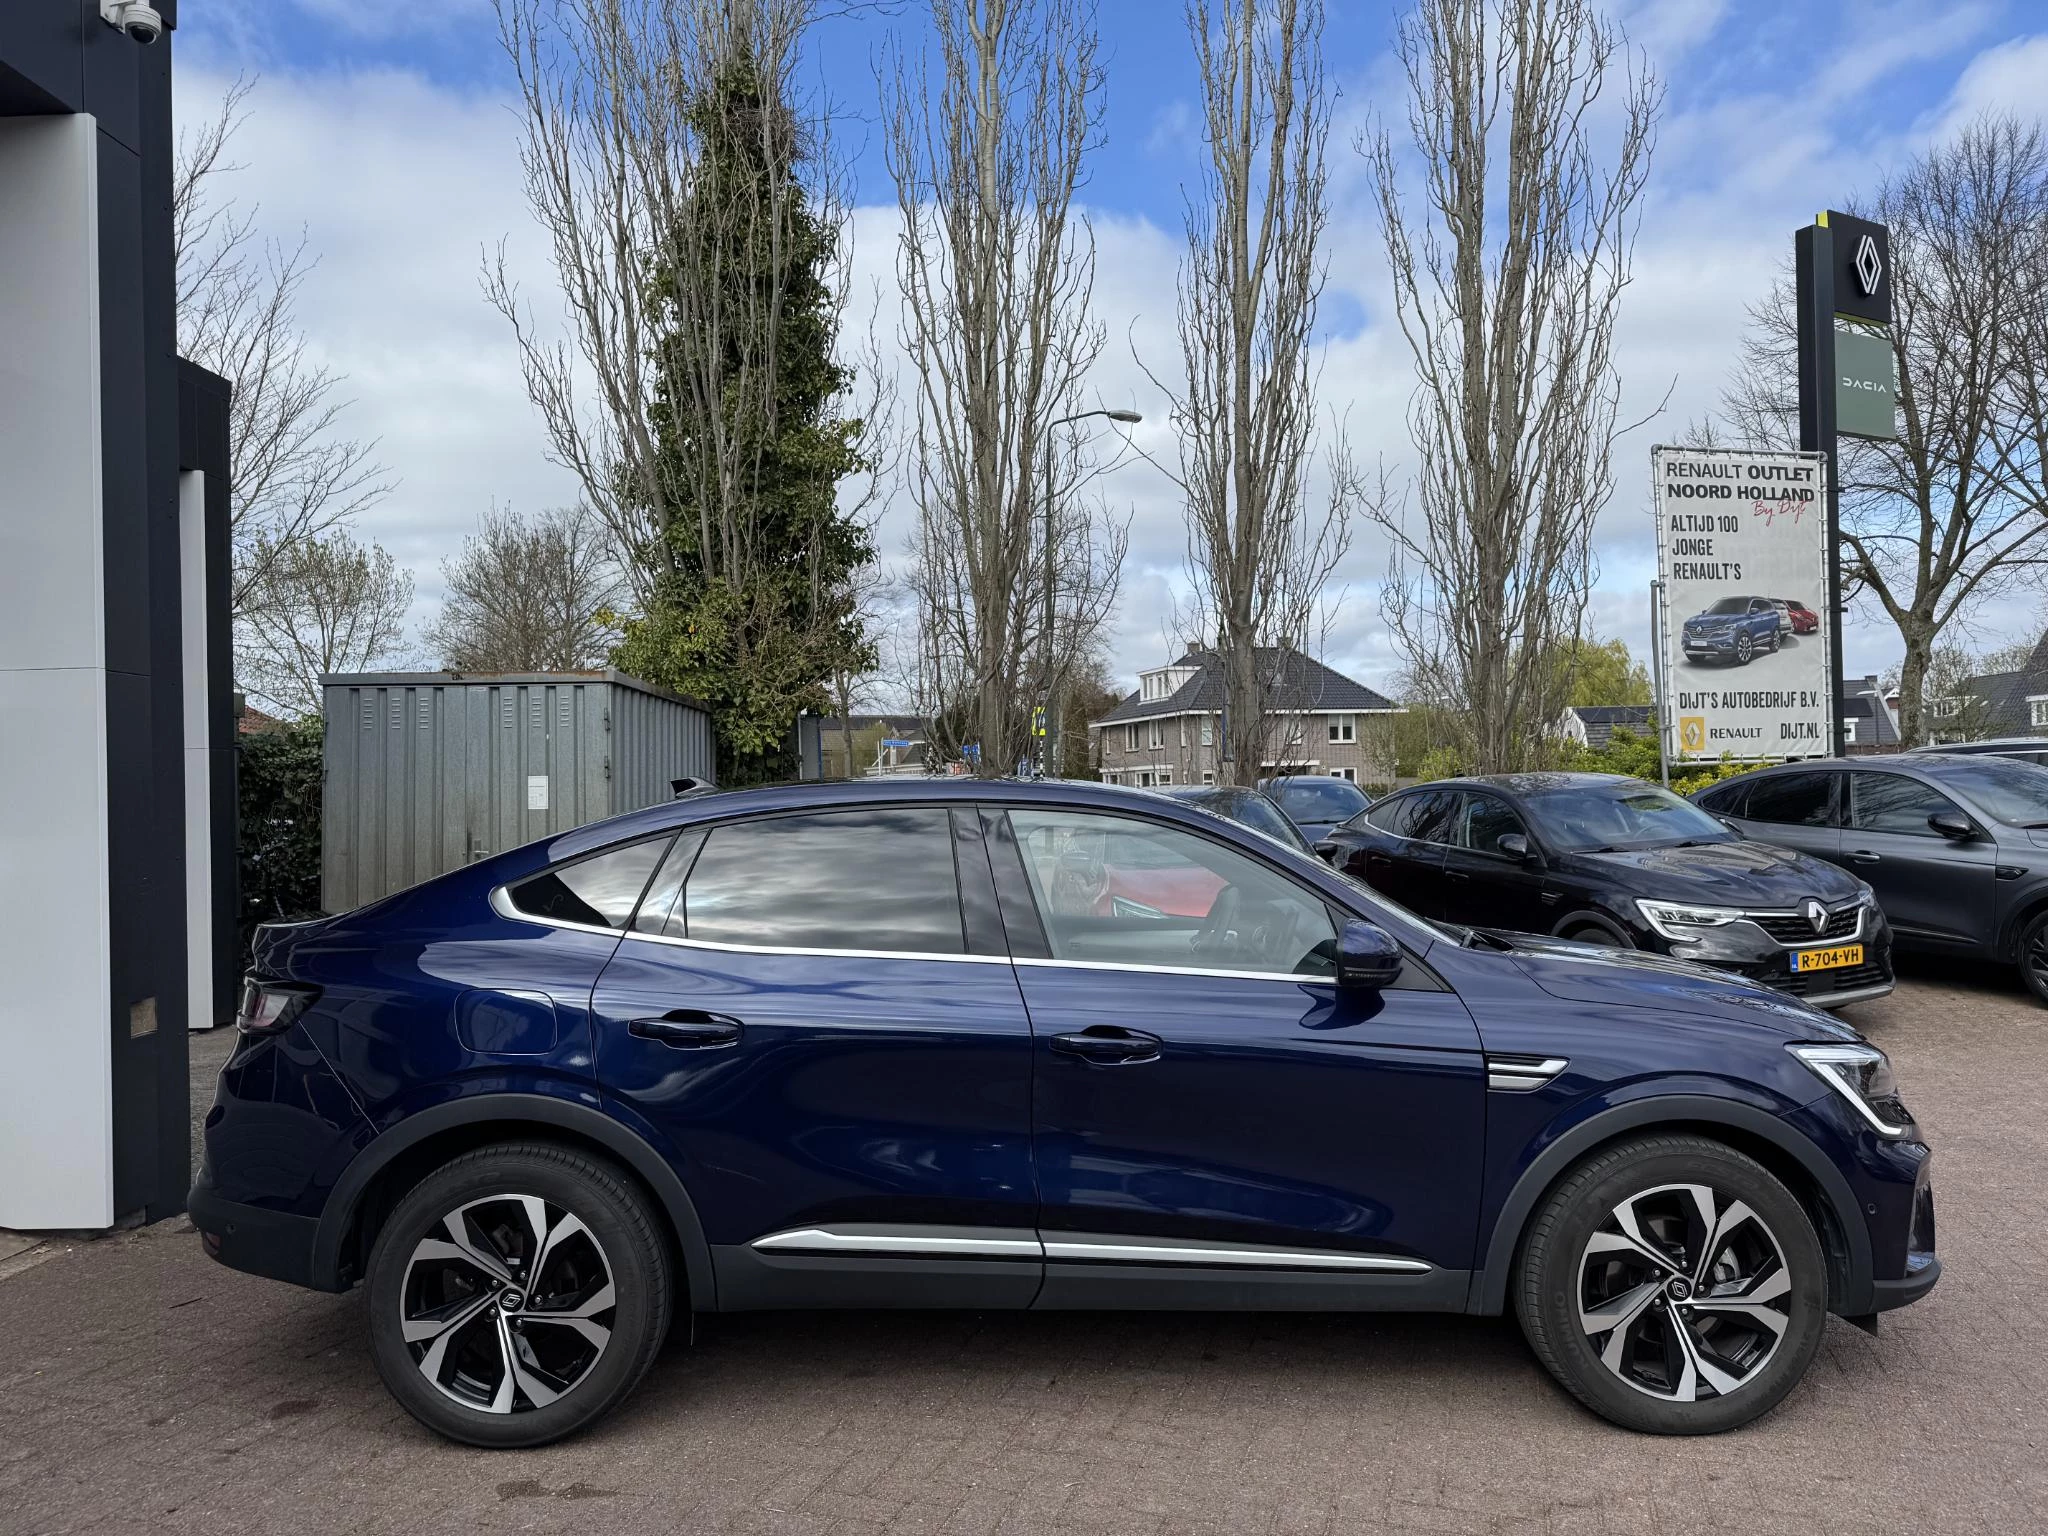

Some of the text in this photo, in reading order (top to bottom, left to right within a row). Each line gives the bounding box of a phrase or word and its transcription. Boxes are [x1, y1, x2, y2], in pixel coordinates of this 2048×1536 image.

[1842, 377, 1887, 393] DACIA
[1666, 462, 1813, 482] RENAULT OUTLET
[1667, 483, 1815, 502] NOORD HOLLAND
[1751, 500, 1775, 526] By
[1671, 514, 1739, 533] ALTIJD 100
[1672, 538, 1714, 556] JONGE
[1673, 562, 1742, 580] RENAULT'S
[1679, 691, 1819, 709] DIJT'S AUTOBEDRIJF B.V.
[1710, 727, 1763, 739] RENAULT
[1780, 722, 1820, 740] DIJT.NL
[1802, 947, 1859, 969] R-704-VH
